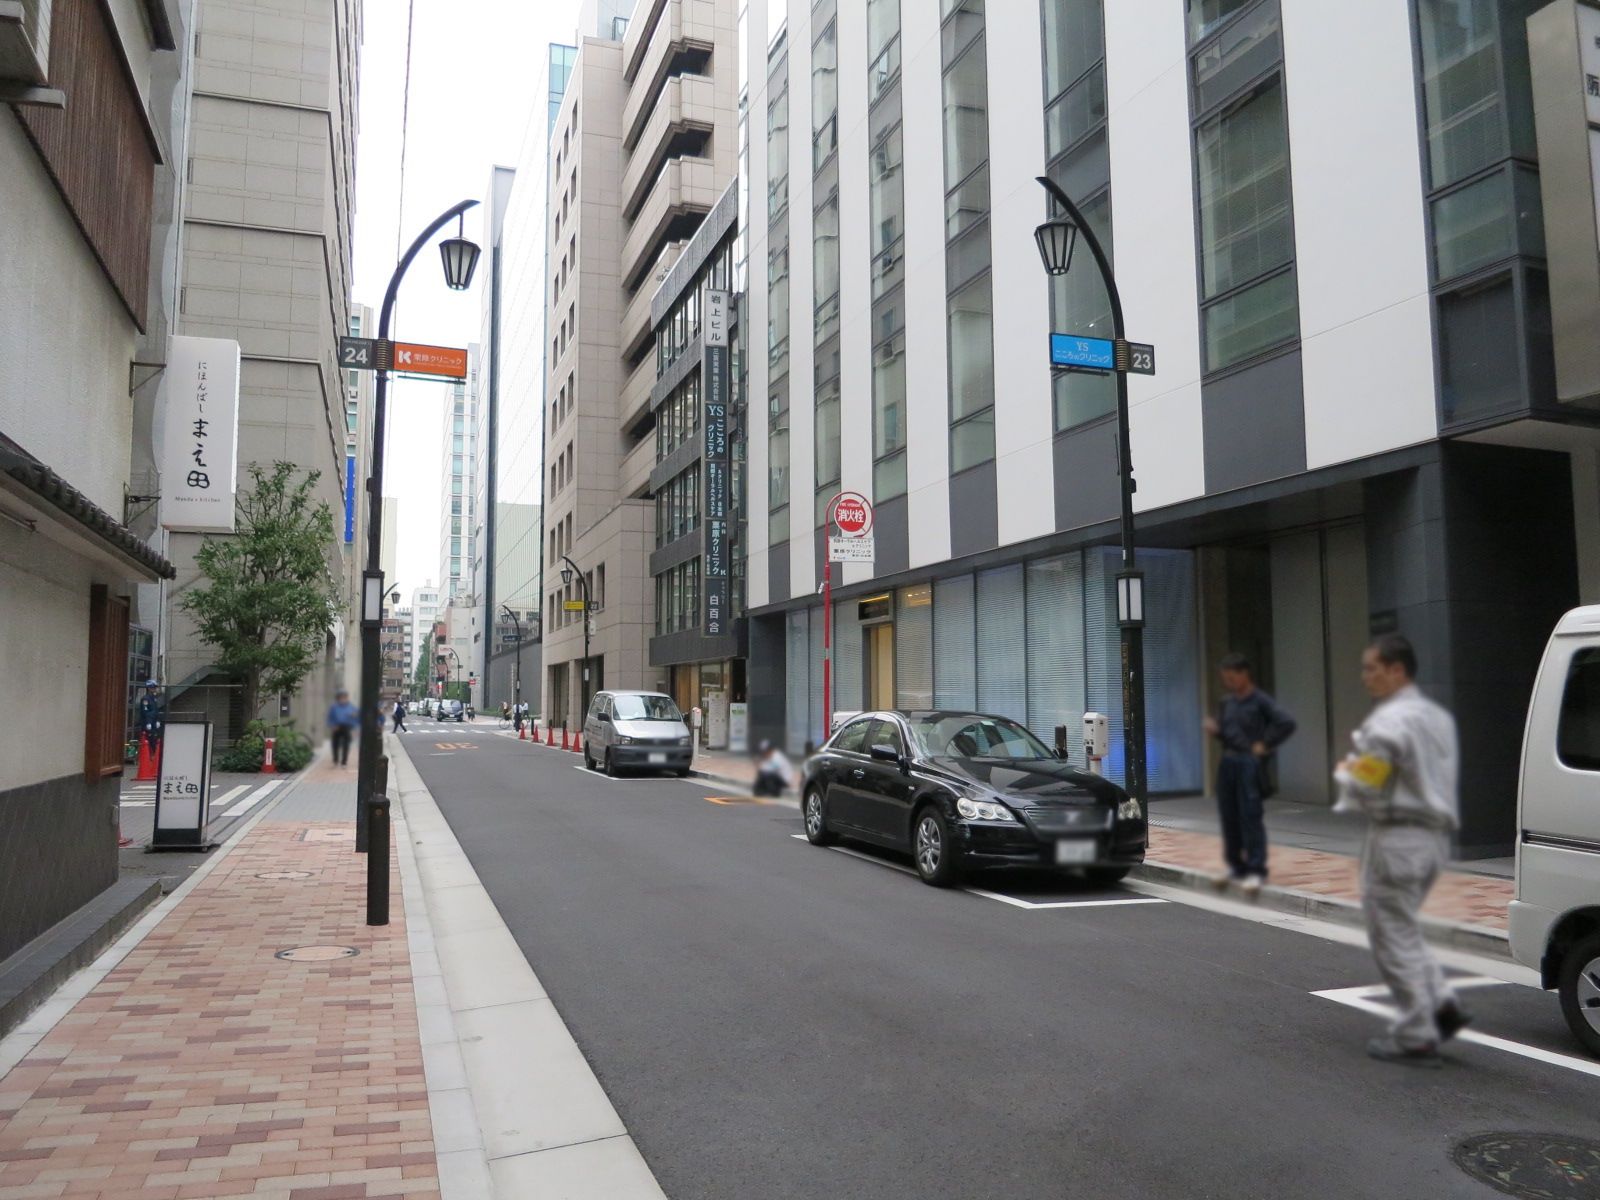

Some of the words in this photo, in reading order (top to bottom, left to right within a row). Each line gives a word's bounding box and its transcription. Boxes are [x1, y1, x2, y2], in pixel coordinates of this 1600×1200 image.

[711, 294, 722, 342] 岩上ビル
[344, 347, 368, 364] 24
[1076, 342, 1089, 352] YS
[1133, 353, 1151, 369] 23
[196, 361, 208, 413] にほんばし
[708, 405, 724, 417] YS
[707, 424, 715, 458] クリニック
[187, 418, 210, 489] まえ田
[838, 508, 865, 523] 消火栓
[709, 594, 720, 633] 白百合
[164, 782, 198, 794] まえ田
